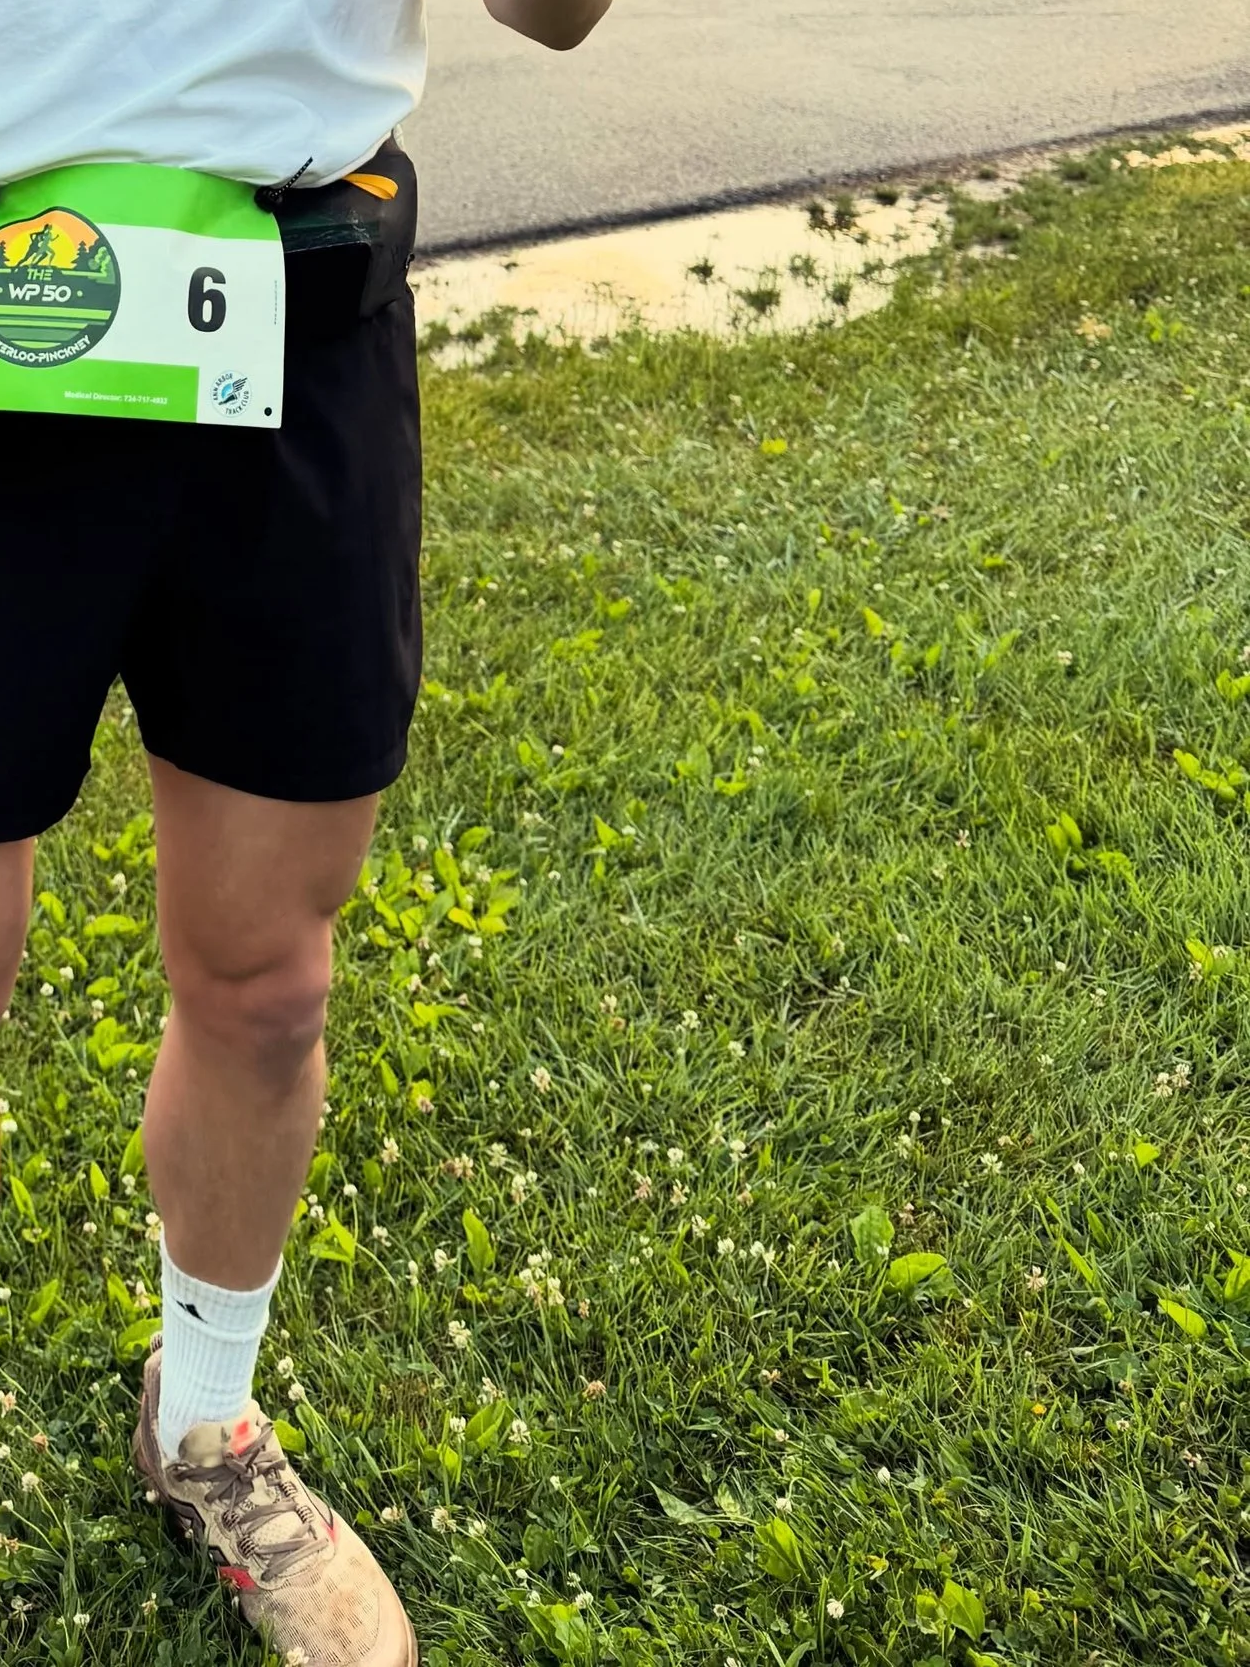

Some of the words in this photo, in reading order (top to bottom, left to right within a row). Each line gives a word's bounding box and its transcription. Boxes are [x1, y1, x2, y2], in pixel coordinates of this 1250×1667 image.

[27, 268, 53, 281] THE
[8, 283, 40, 301] WP
[41, 284, 72, 302] 50
[187, 266, 227, 333] 6
[64, 390, 92, 399] Medical
